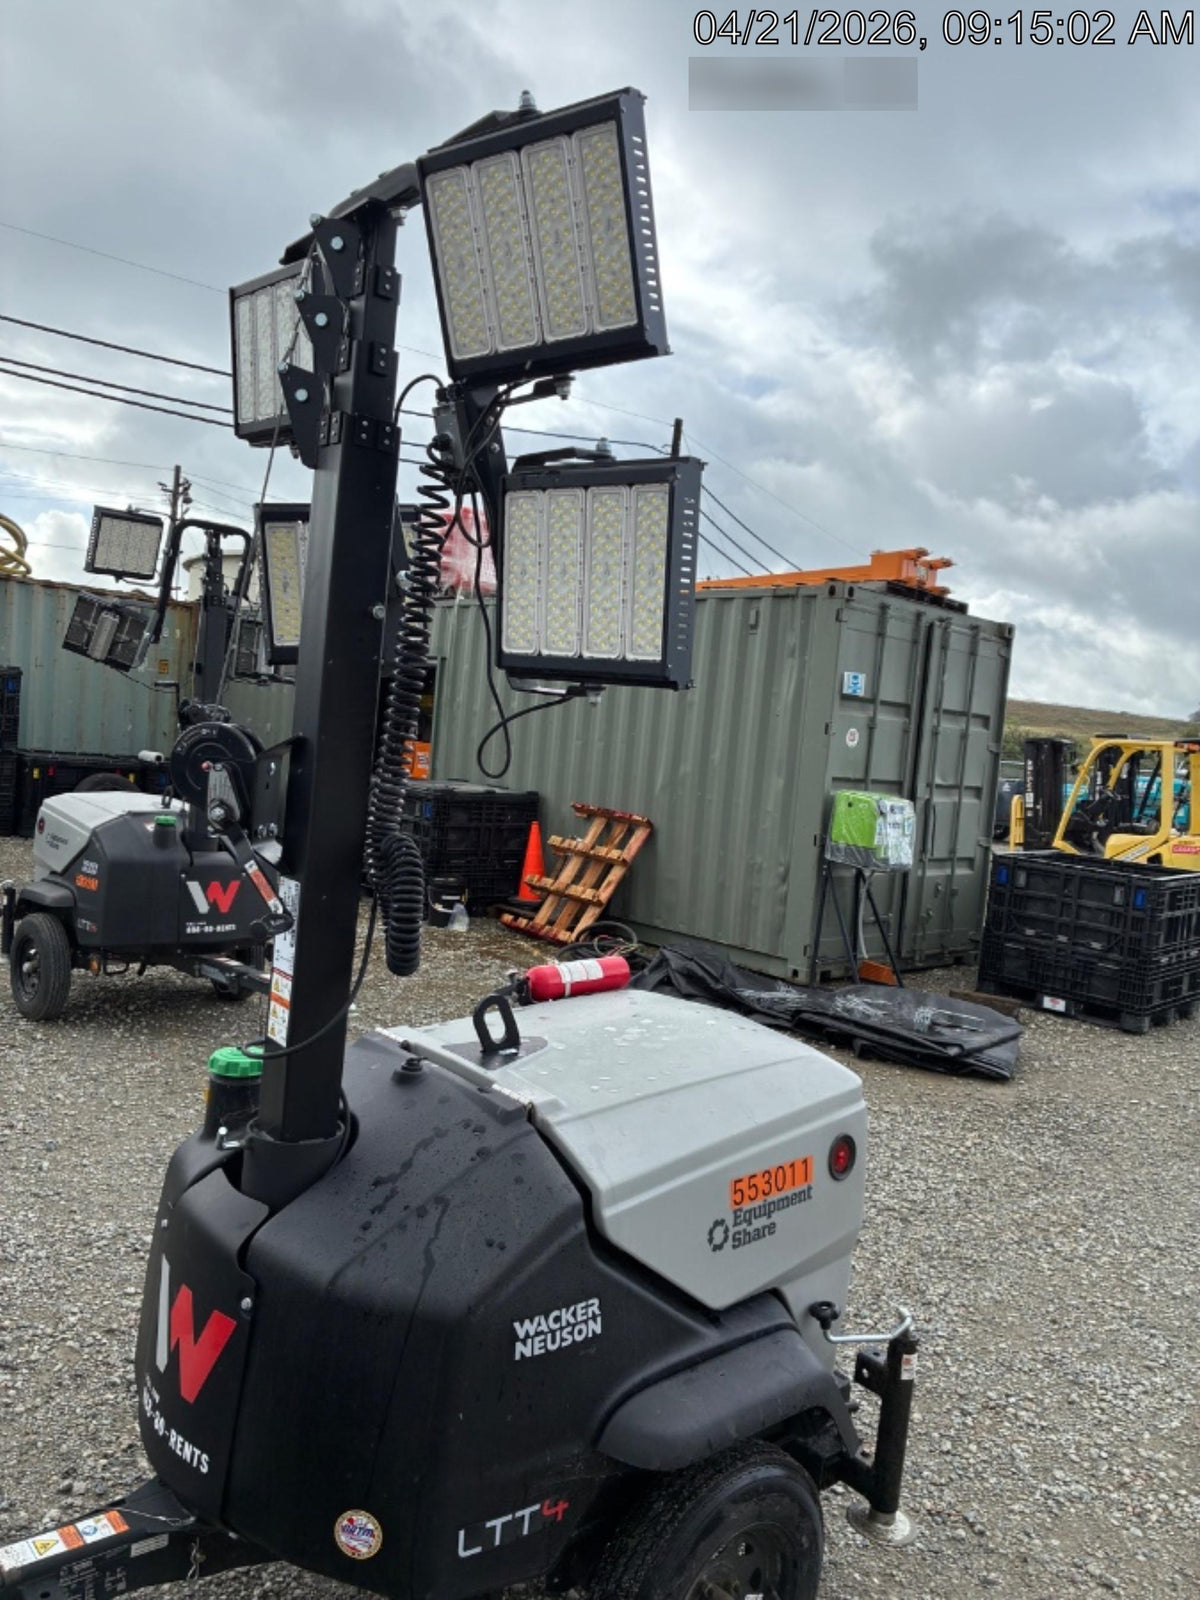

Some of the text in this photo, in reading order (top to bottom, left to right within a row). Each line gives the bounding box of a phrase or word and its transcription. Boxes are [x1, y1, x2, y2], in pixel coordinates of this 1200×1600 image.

[732, 1158, 809, 1206] 553011
[732, 1184, 813, 1228] Equipment
[731, 1221, 777, 1250] Share
[513, 1297, 602, 1339] WACKER
[514, 1317, 602, 1361] NEUSON
[457, 1498, 569, 1558] LTT4
